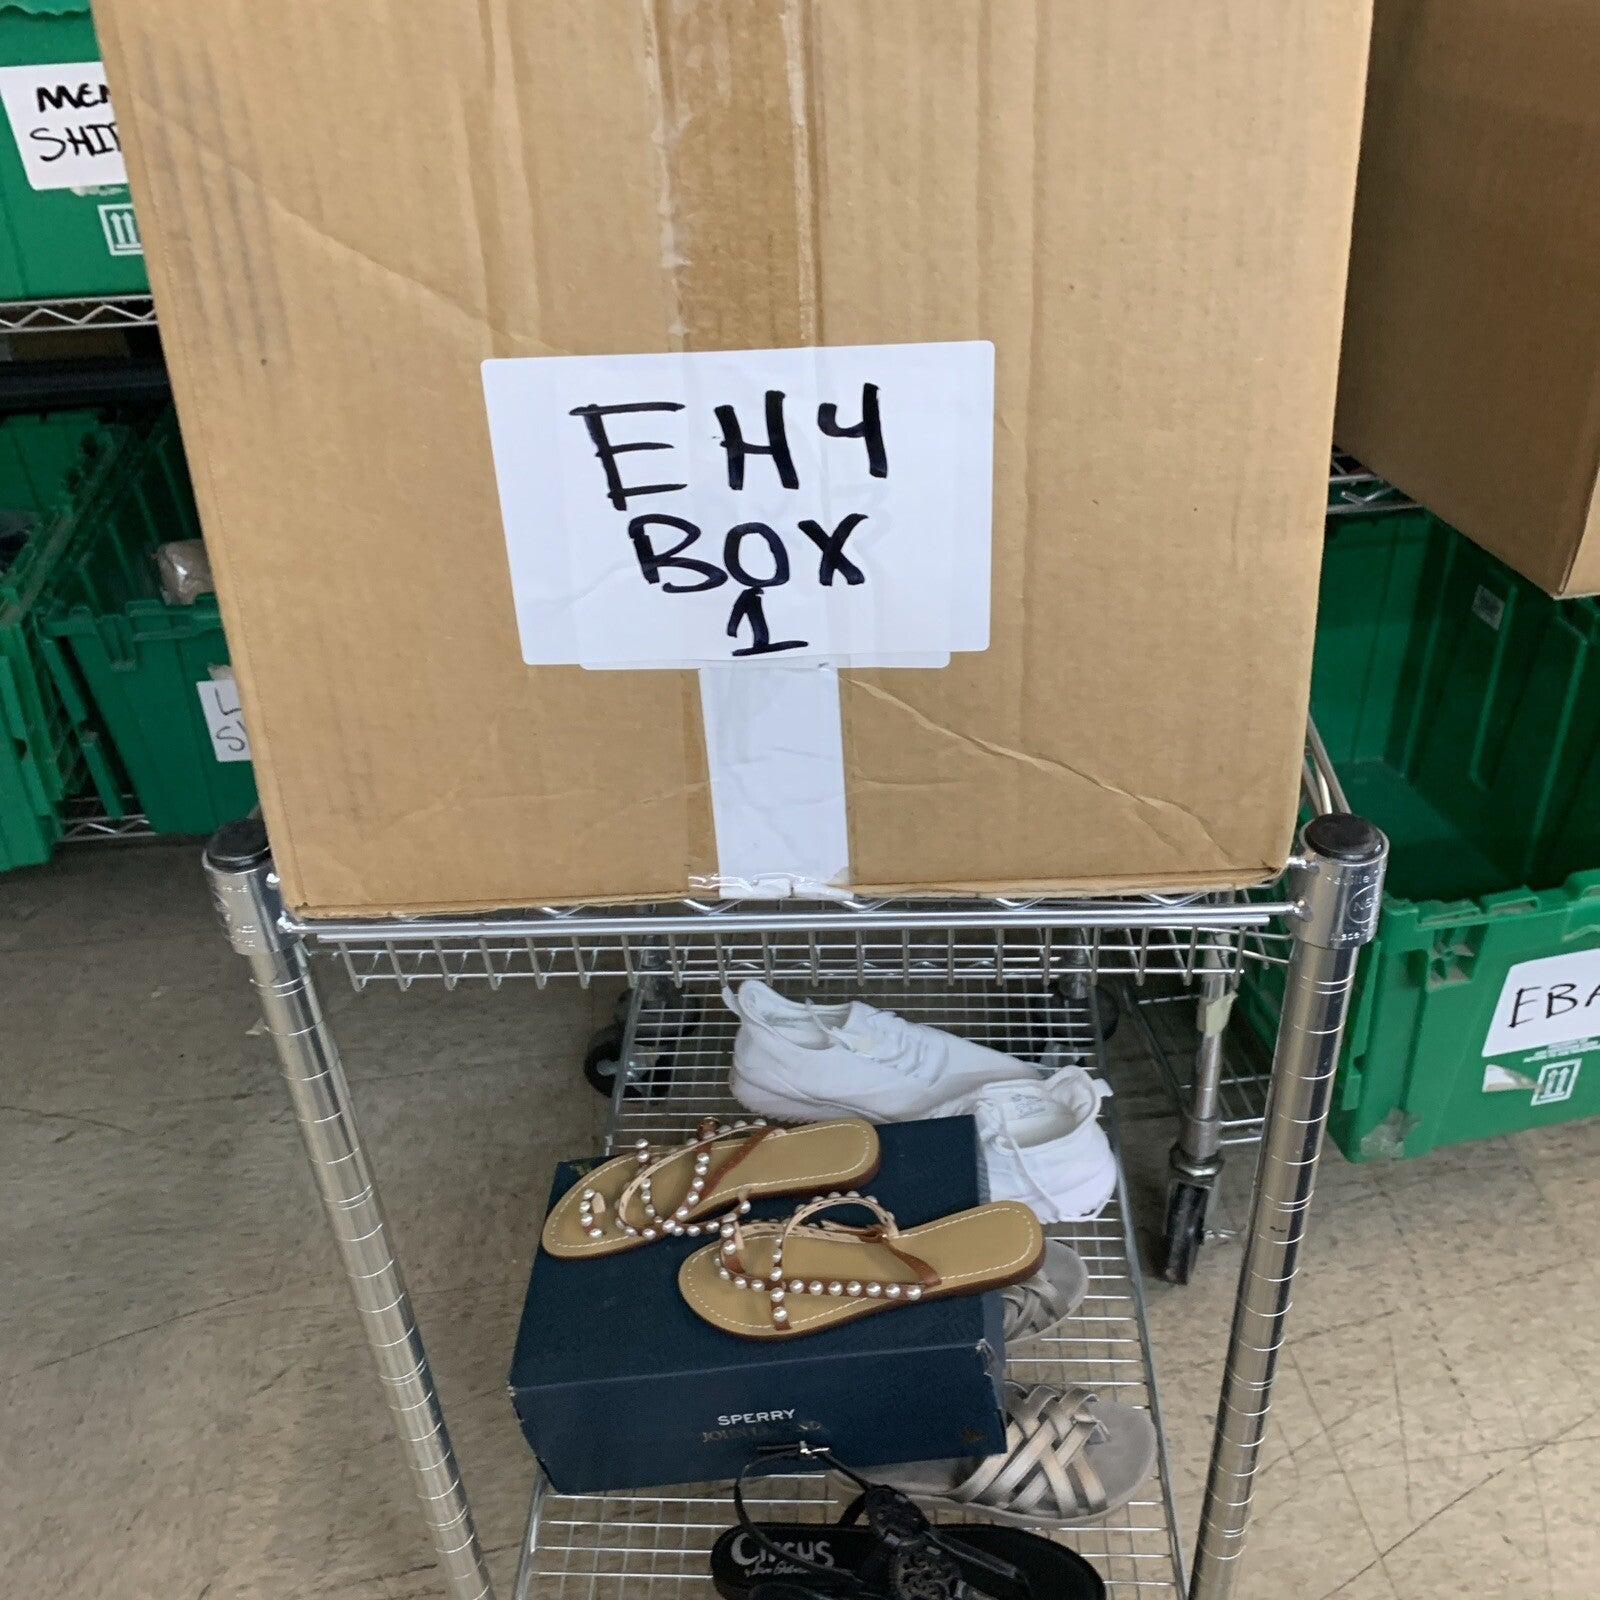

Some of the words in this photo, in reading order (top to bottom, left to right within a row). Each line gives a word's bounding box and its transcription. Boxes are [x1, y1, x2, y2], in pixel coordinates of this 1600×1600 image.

[628, 513, 869, 594] BOX
[726, 586, 809, 657] 1
[717, 1408, 796, 1427] SPERRY
